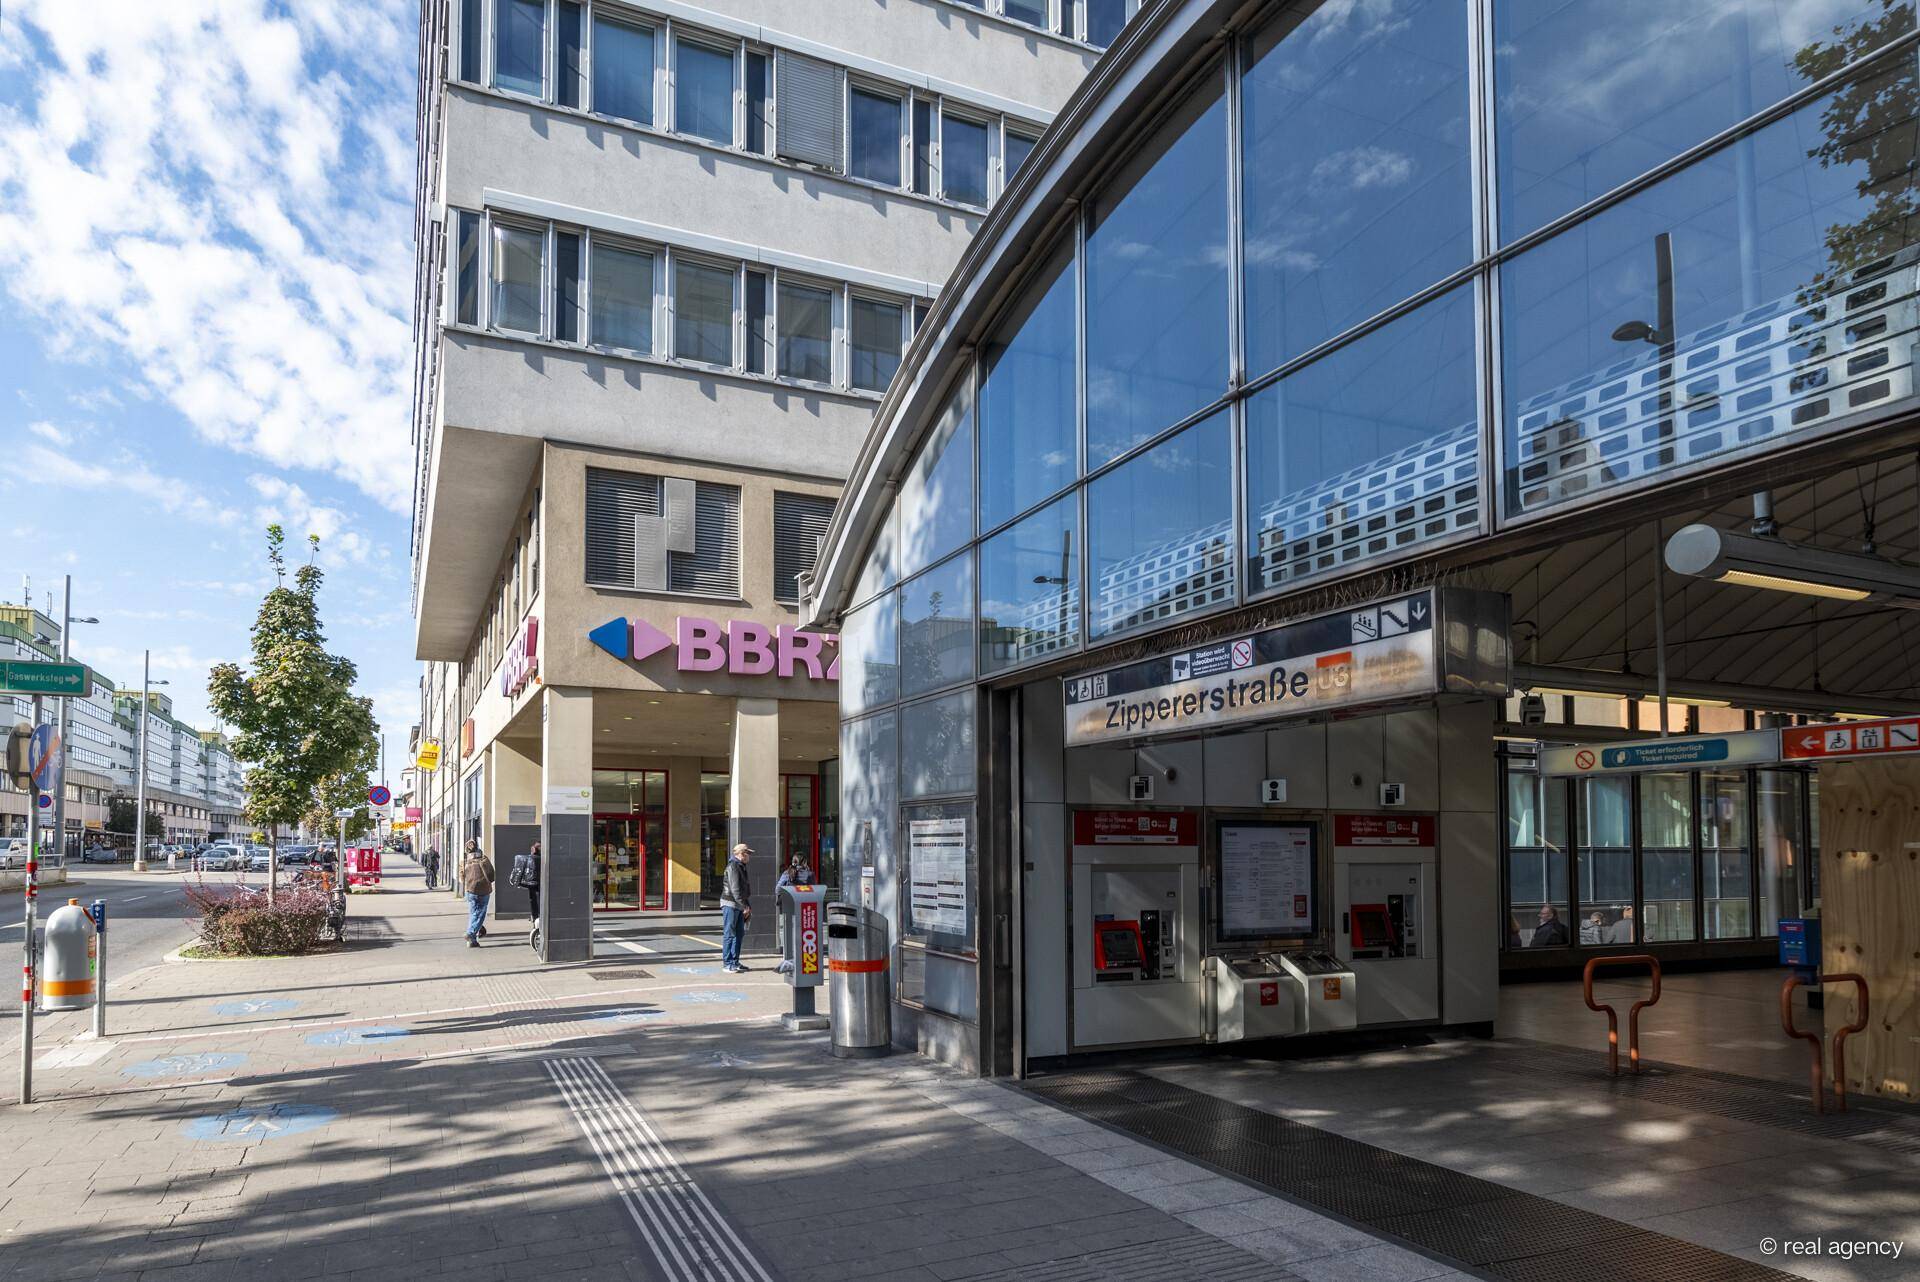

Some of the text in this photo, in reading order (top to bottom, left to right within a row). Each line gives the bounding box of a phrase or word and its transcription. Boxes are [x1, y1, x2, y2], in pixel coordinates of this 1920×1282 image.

[1191, 652, 1231, 667] videoüberwacht
[1196, 647, 1225, 659] Station wird
[8, 671, 64, 685] Gaswerksteg
[1105, 665, 1350, 732] Zippererstraße U3
[1635, 743, 1704, 756] Ticket erforderlich
[1641, 751, 1698, 763] Ticket required
